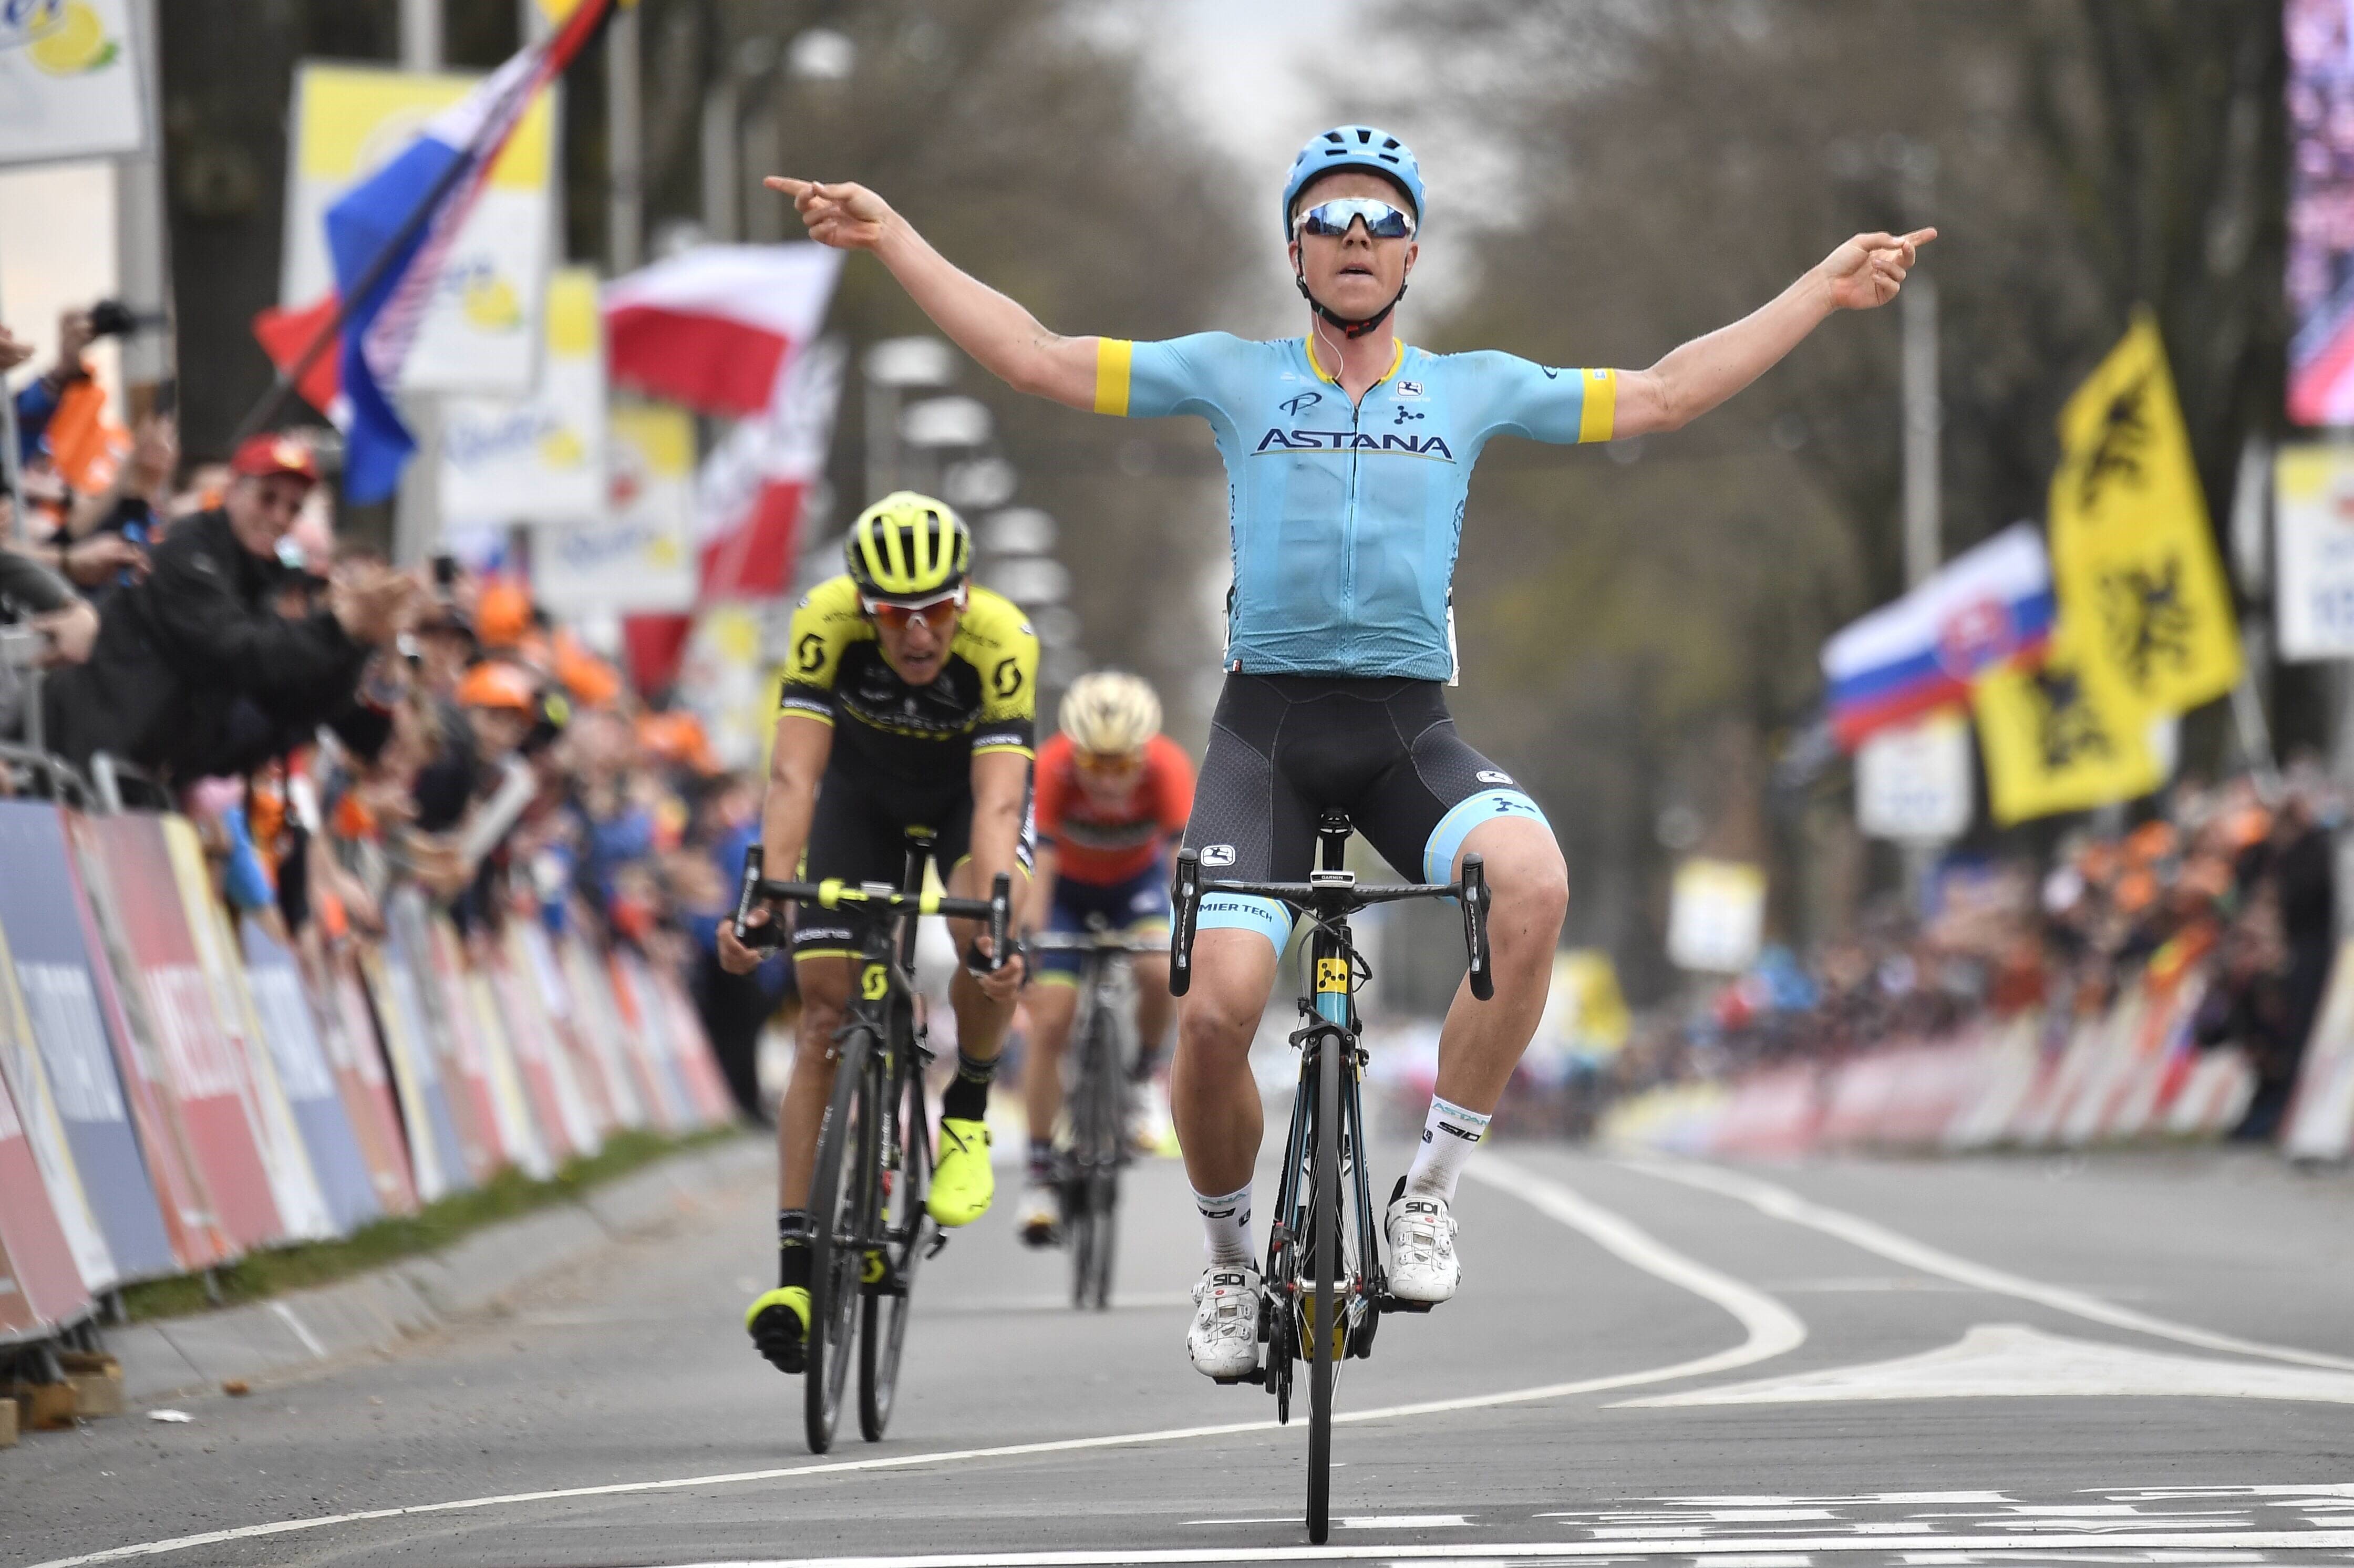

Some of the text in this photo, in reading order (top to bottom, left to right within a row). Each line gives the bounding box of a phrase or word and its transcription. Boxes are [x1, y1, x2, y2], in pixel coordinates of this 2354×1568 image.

[1256, 428, 1452, 460] ASTANA
[1199, 903, 1272, 923] MIER TECH
[1433, 1103, 1486, 1126] ASTAN
[1437, 1121, 1482, 1142] SID
[1405, 1201, 1438, 1216] SIDI
[1213, 1273, 1245, 1287] SIDI
